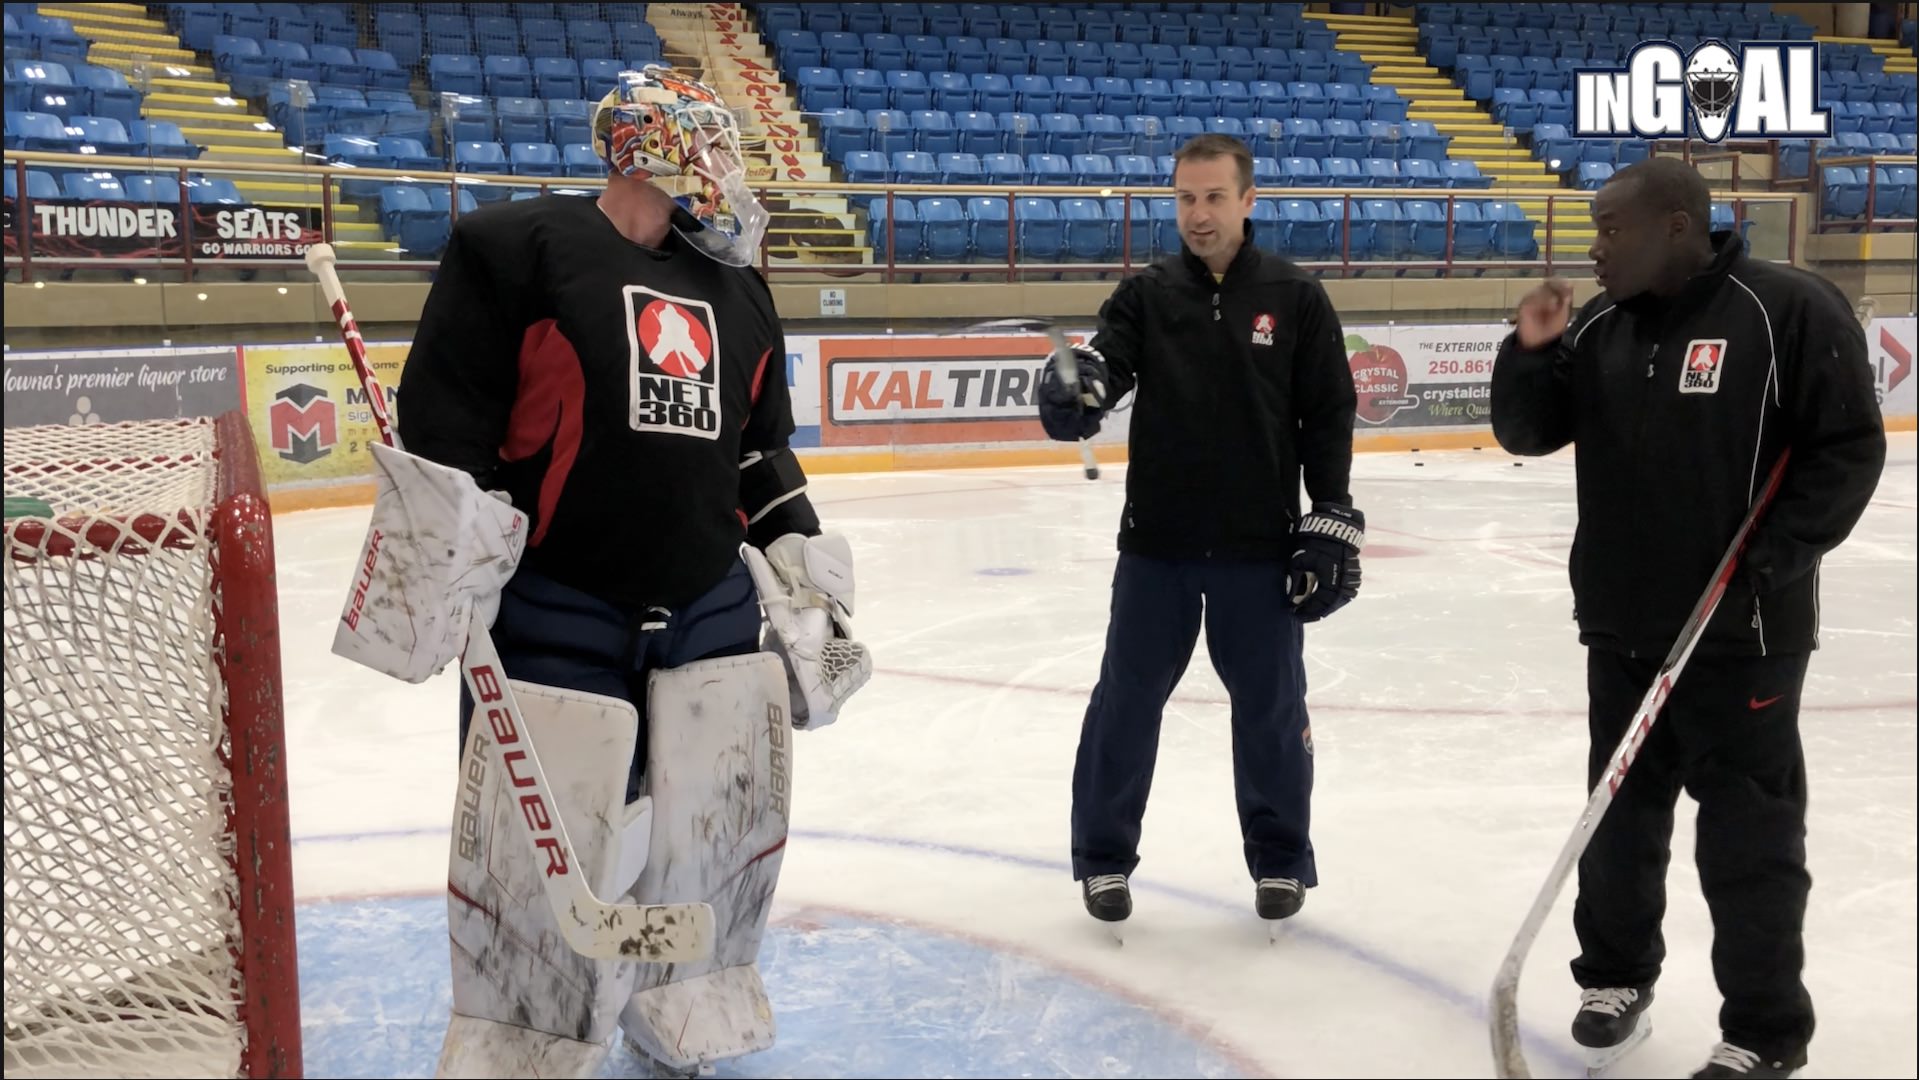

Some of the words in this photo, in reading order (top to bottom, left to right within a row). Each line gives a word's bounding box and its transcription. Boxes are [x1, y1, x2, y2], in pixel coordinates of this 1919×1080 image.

[34, 204, 177, 238] THUNDER
[216, 210, 301, 240] SEATS
[202, 242, 220, 255] GO
[223, 243, 292, 255] WARRIORS
[1435, 342, 1493, 352] EXTERIOR
[65, 367, 134, 396] premier
[137, 364, 185, 392] liquor
[188, 365, 227, 383] store
[265, 363, 335, 376] Supporting
[338, 363, 355, 371] ou
[1353, 367, 1399, 379] CRYSTAL
[1685, 372, 1713, 380] NET
[639, 376, 714, 408] NET
[1684, 380, 1714, 388] 360
[639, 401, 716, 432] 360
[1429, 404, 1463, 416] Where
[344, 529, 385, 632] BAUER
[470, 665, 569, 879] BAUER
[458, 733, 491, 862] BAUER
